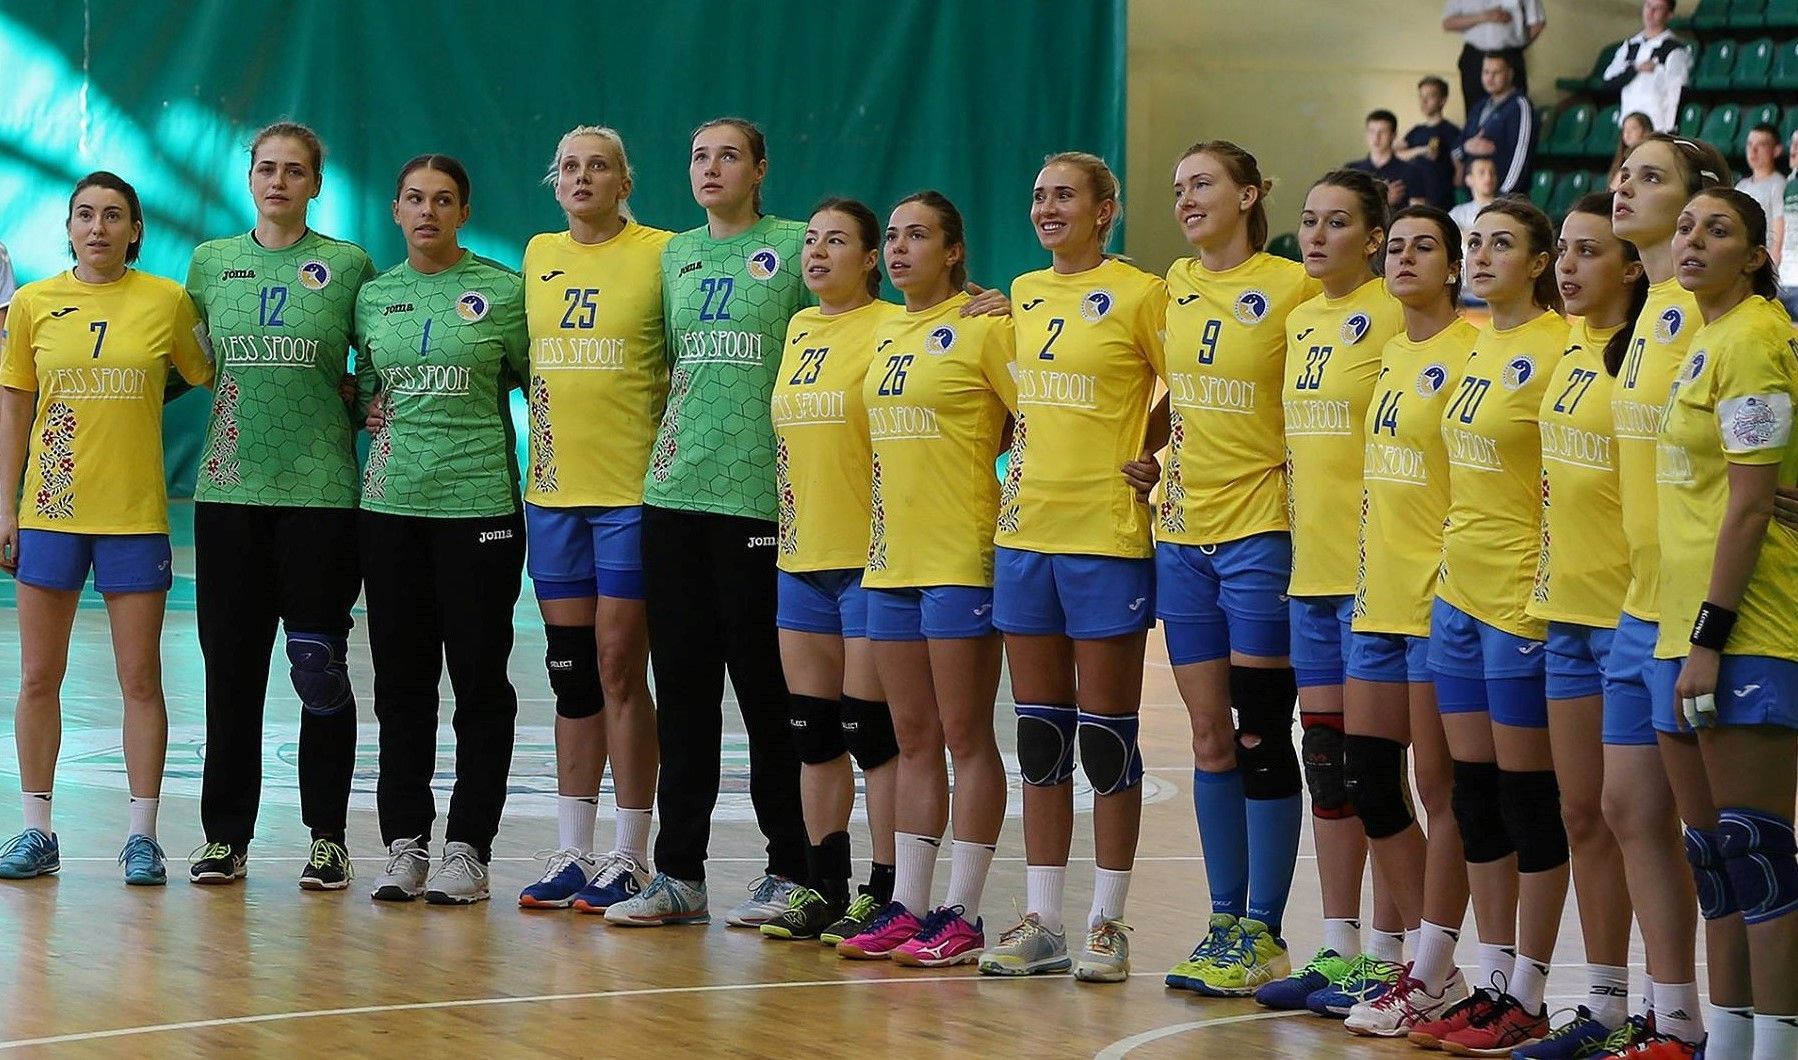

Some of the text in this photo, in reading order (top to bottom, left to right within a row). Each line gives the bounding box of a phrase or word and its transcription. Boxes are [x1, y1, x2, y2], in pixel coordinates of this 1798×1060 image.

[258, 286, 288, 327] 12
[560, 288, 600, 329] 25
[700, 277, 734, 321] 22
[90, 321, 108, 359] 7
[221, 335, 319, 362] LESS SPOON
[420, 318, 432, 356] 1
[535, 338, 625, 364] LESS SPOON
[708, 330, 763, 359] SPOON
[1038, 318, 1065, 361] 2
[1198, 319, 1222, 365] 9
[91, 367, 147, 393] SPOON
[417, 365, 471, 391] SPOON
[789, 347, 830, 386] 23
[878, 354, 914, 396] 26
[1295, 346, 1333, 390] 33
[795, 391, 846, 419] SPOON
[1040, 370, 1096, 403] SPOON
[1199, 375, 1256, 408] SPOON
[1447, 375, 1491, 424] 70
[1553, 367, 1598, 415] 27
[889, 406, 941, 433] SPOON
[1302, 400, 1350, 428] SPOON
[1373, 390, 1404, 437] 14
[1560, 425, 1611, 464] SPOON
[479, 530, 513, 543] Joma
[747, 536, 779, 548] Jom
